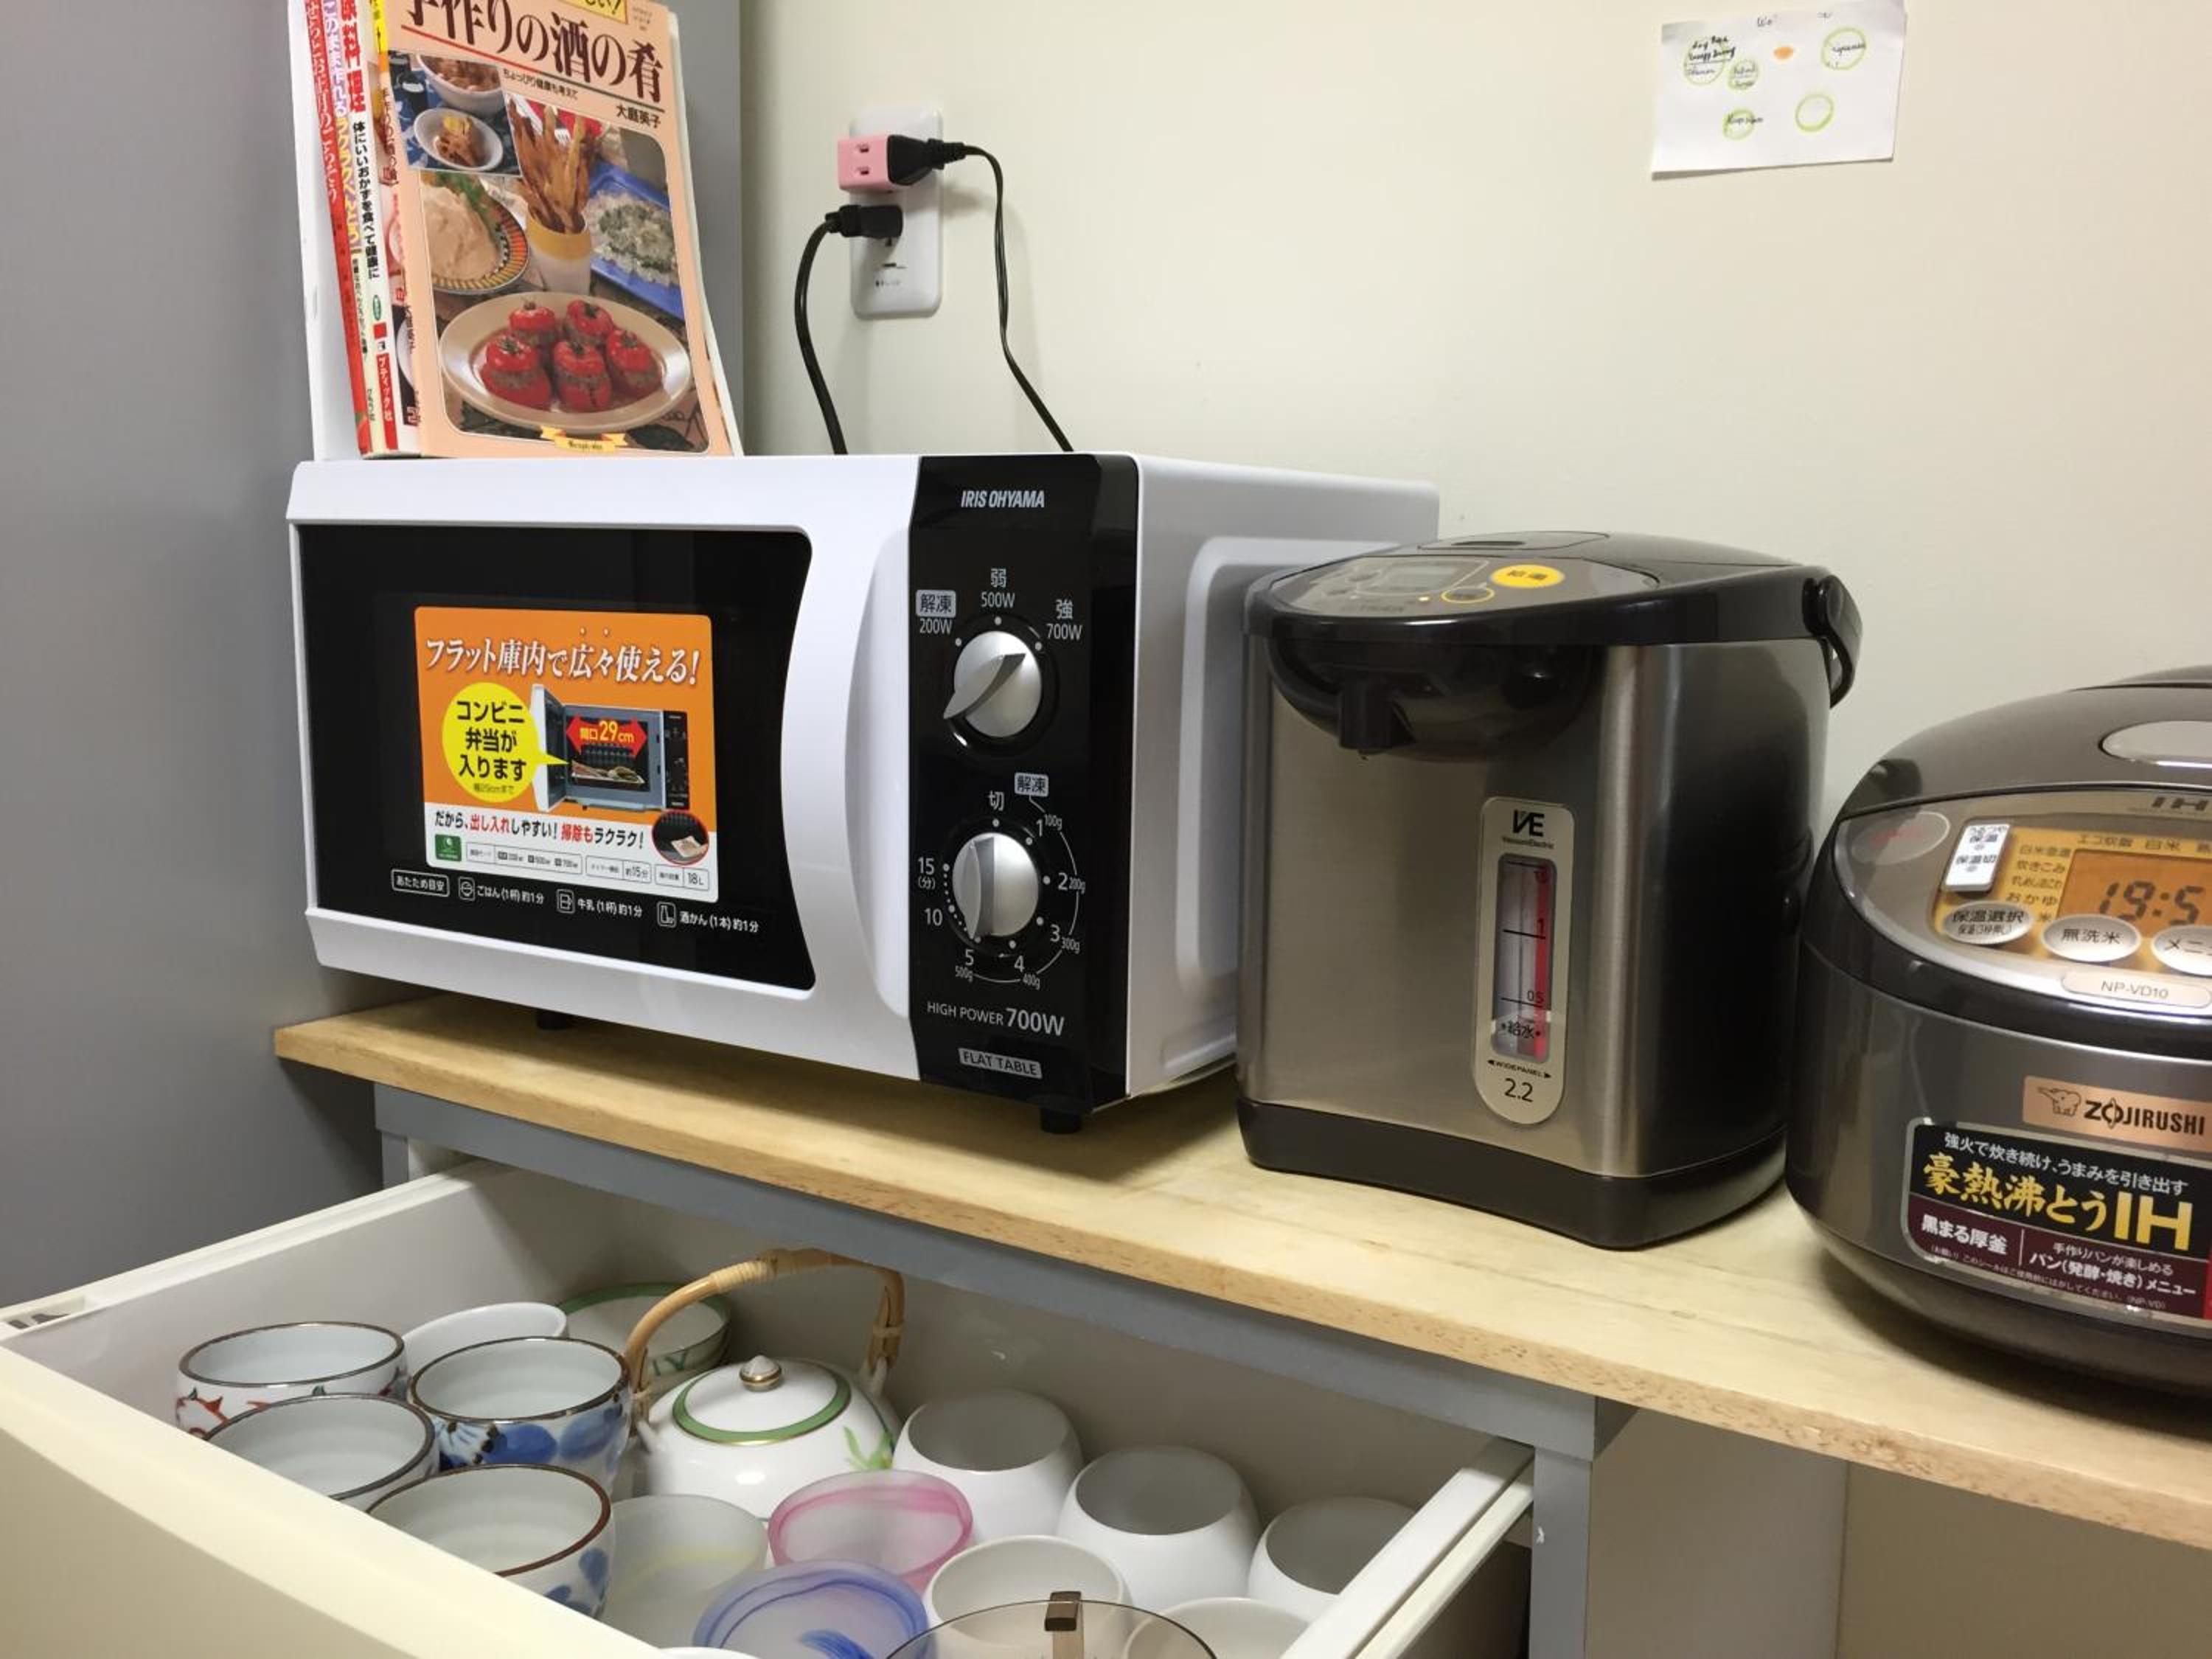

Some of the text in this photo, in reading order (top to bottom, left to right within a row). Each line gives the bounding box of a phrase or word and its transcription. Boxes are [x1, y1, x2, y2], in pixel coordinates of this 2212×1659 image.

[616, 104, 661, 128] 大庭英子
[353, 122, 380, 279] 体にいいおかずを食べて健康に
[961, 490, 1045, 508] IRIS OHYAMA
[990, 568, 1006, 588] 弱
[919, 593, 952, 613] 解凍
[981, 592, 1015, 608] 500W
[1055, 599, 1074, 619] 強
[919, 618, 953, 634] 200W
[1046, 623, 1082, 641] 700W
[425, 637, 700, 685] フラット庫内で広々使える!
[456, 700, 525, 723] コンビニ
[465, 727, 518, 752] 弁当が
[458, 754, 526, 782] 入ります
[1017, 775, 1047, 793] 解凍
[987, 790, 1005, 811] 切
[1036, 814, 1062, 837] 1 100g
[2145, 838, 2181, 851] 白米
[918, 857, 935, 875] 15
[396, 876, 445, 891] あたため目安
[1058, 872, 1086, 894] 2 200g
[2006, 891, 2058, 905] おかゆ
[925, 908, 943, 926] 10
[1537, 919, 1544, 932] 1
[1050, 924, 1080, 954] 3 300g
[2061, 928, 2212, 957] 無洗米 メニ
[965, 949, 974, 966] 5
[1014, 955, 1040, 990] 4 400g
[2100, 980, 2169, 999] NP-VD10
[927, 1001, 1065, 1036] HIGH POWER 700W
[963, 1051, 1037, 1076] FLAT TABLE
[1504, 1077, 1534, 1103] 2.2
[2084, 1097, 2205, 1136] ZOJIRUSHI
[1944, 1132, 2188, 1197] 強火で炊き続け、うまみを引き出す
[1924, 1152, 2193, 1251] 豪熱沸とうIH
[1921, 1214, 2008, 1255] 黒まる厚釜
[2053, 1242, 2174, 1276] 手作りパンが楽しめる
